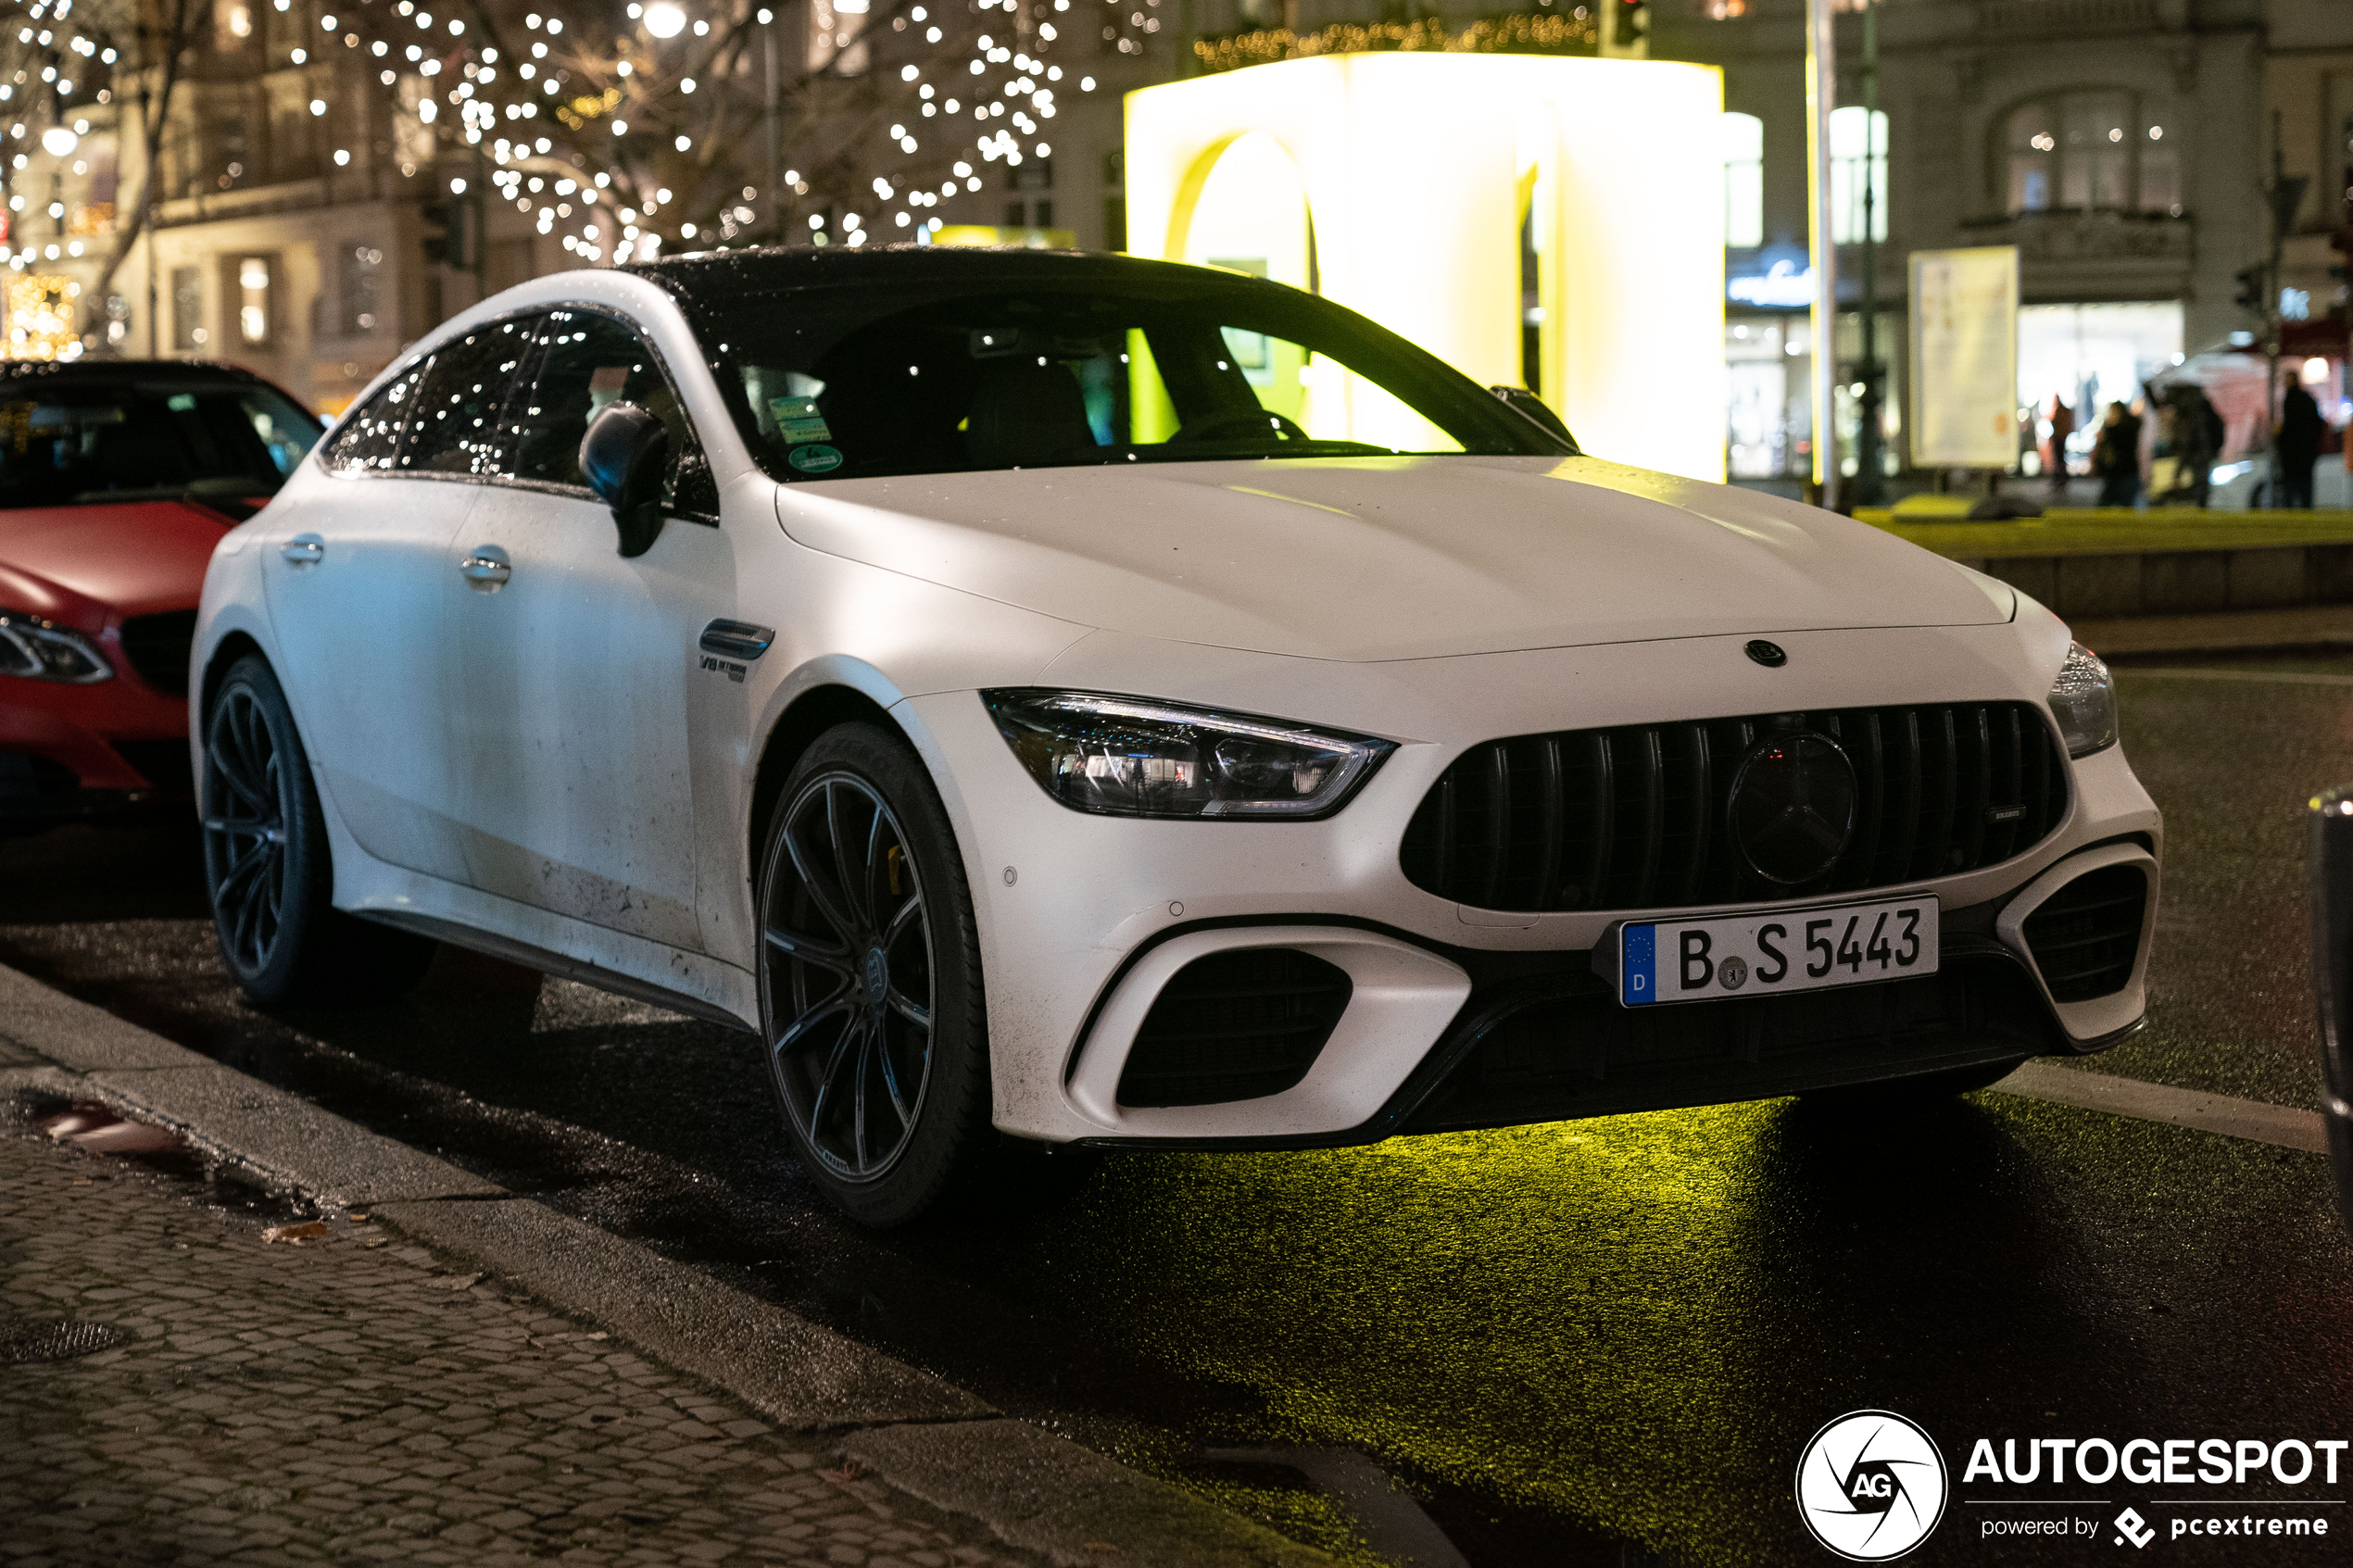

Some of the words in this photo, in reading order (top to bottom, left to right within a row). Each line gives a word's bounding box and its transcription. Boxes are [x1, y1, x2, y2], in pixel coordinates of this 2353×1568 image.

[1680, 930, 1714, 989] B
[1755, 923, 1788, 984] S
[1806, 908, 1921, 978] 5443
[1633, 973, 1645, 991] D
